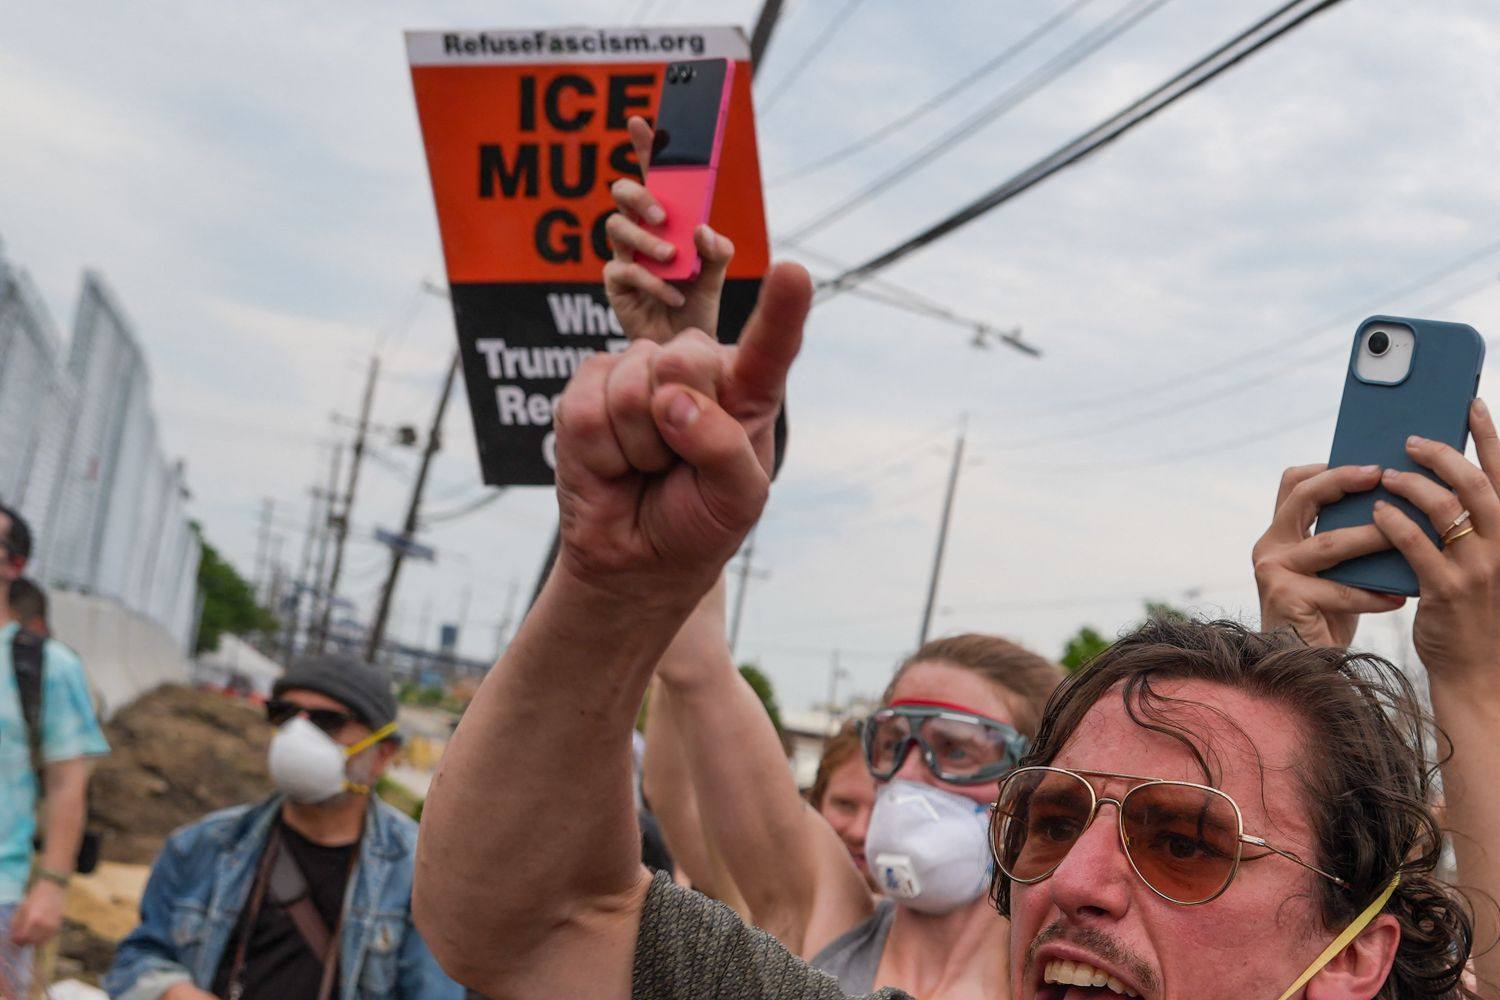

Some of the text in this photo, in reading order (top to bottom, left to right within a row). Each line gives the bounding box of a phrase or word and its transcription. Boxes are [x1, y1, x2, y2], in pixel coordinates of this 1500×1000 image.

[443, 32, 705, 56] RefuseFascism.org
[519, 73, 656, 132] ICE
[475, 337, 589, 379] Trum
[495, 385, 557, 426] Re
